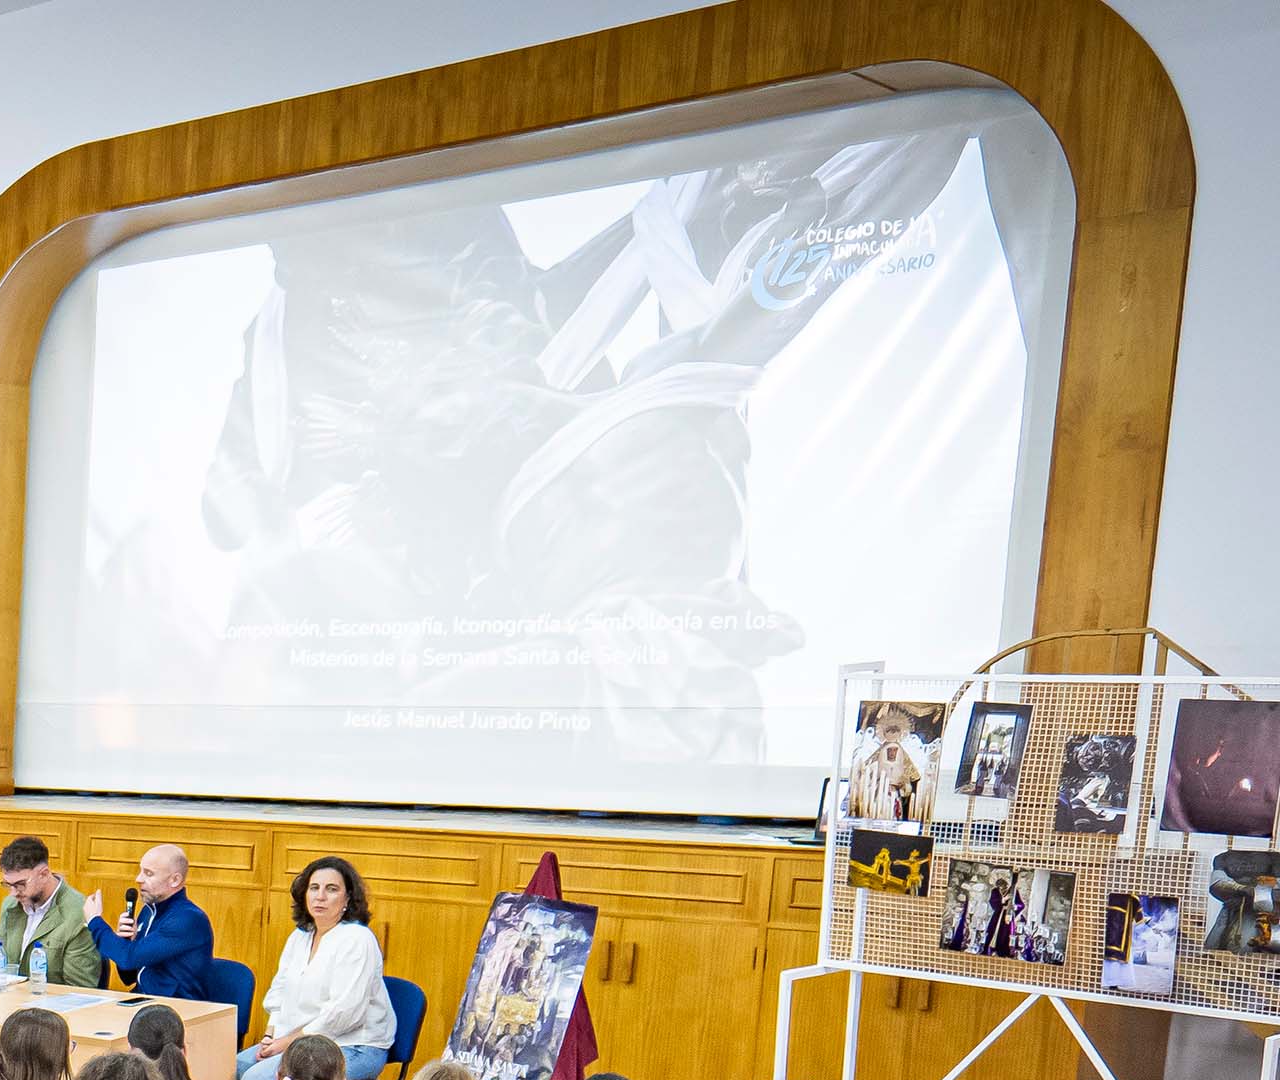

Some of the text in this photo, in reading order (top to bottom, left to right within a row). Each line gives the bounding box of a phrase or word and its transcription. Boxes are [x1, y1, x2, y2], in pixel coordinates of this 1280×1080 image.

[806, 220, 875, 246] COLEGIO
[880, 219, 904, 236] DE
[768, 243, 834, 288] 125
[328, 616, 448, 639] Escenografía,
[453, 612, 562, 638] Iconografía
[583, 610, 707, 634] Simbología
[710, 613, 738, 630] en
[745, 610, 778, 631] los
[289, 649, 370, 667] Misterios
[373, 648, 395, 667] de
[422, 647, 499, 667] Semana
[503, 646, 561, 666] Santa
[566, 646, 590, 665] de
[597, 645, 670, 665] Sevilla
[343, 709, 592, 732] Jesús Manuel Jurado Pinto
